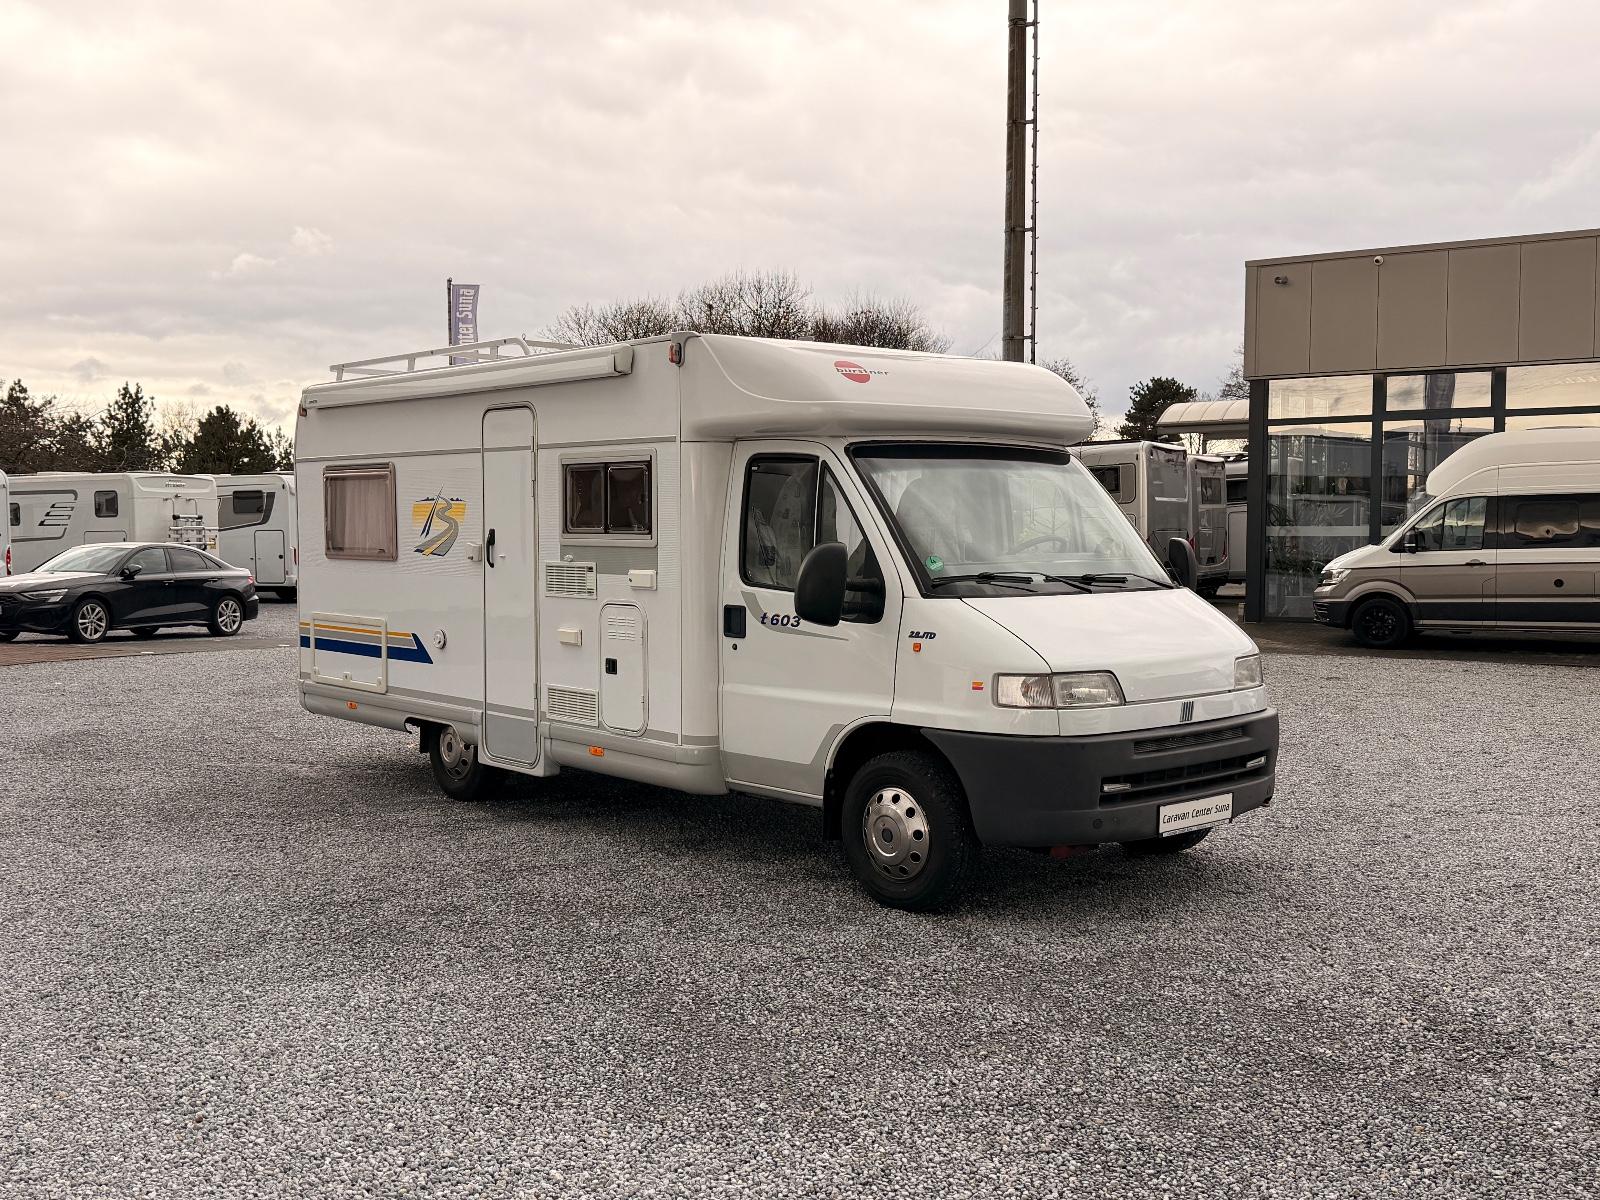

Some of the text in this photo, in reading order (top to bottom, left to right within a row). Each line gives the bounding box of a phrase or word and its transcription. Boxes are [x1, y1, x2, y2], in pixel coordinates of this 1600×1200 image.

[456, 288, 475, 319] Suna
[770, 613, 801, 628] 603
[1162, 803, 1230, 824] Caravan Center Suna
